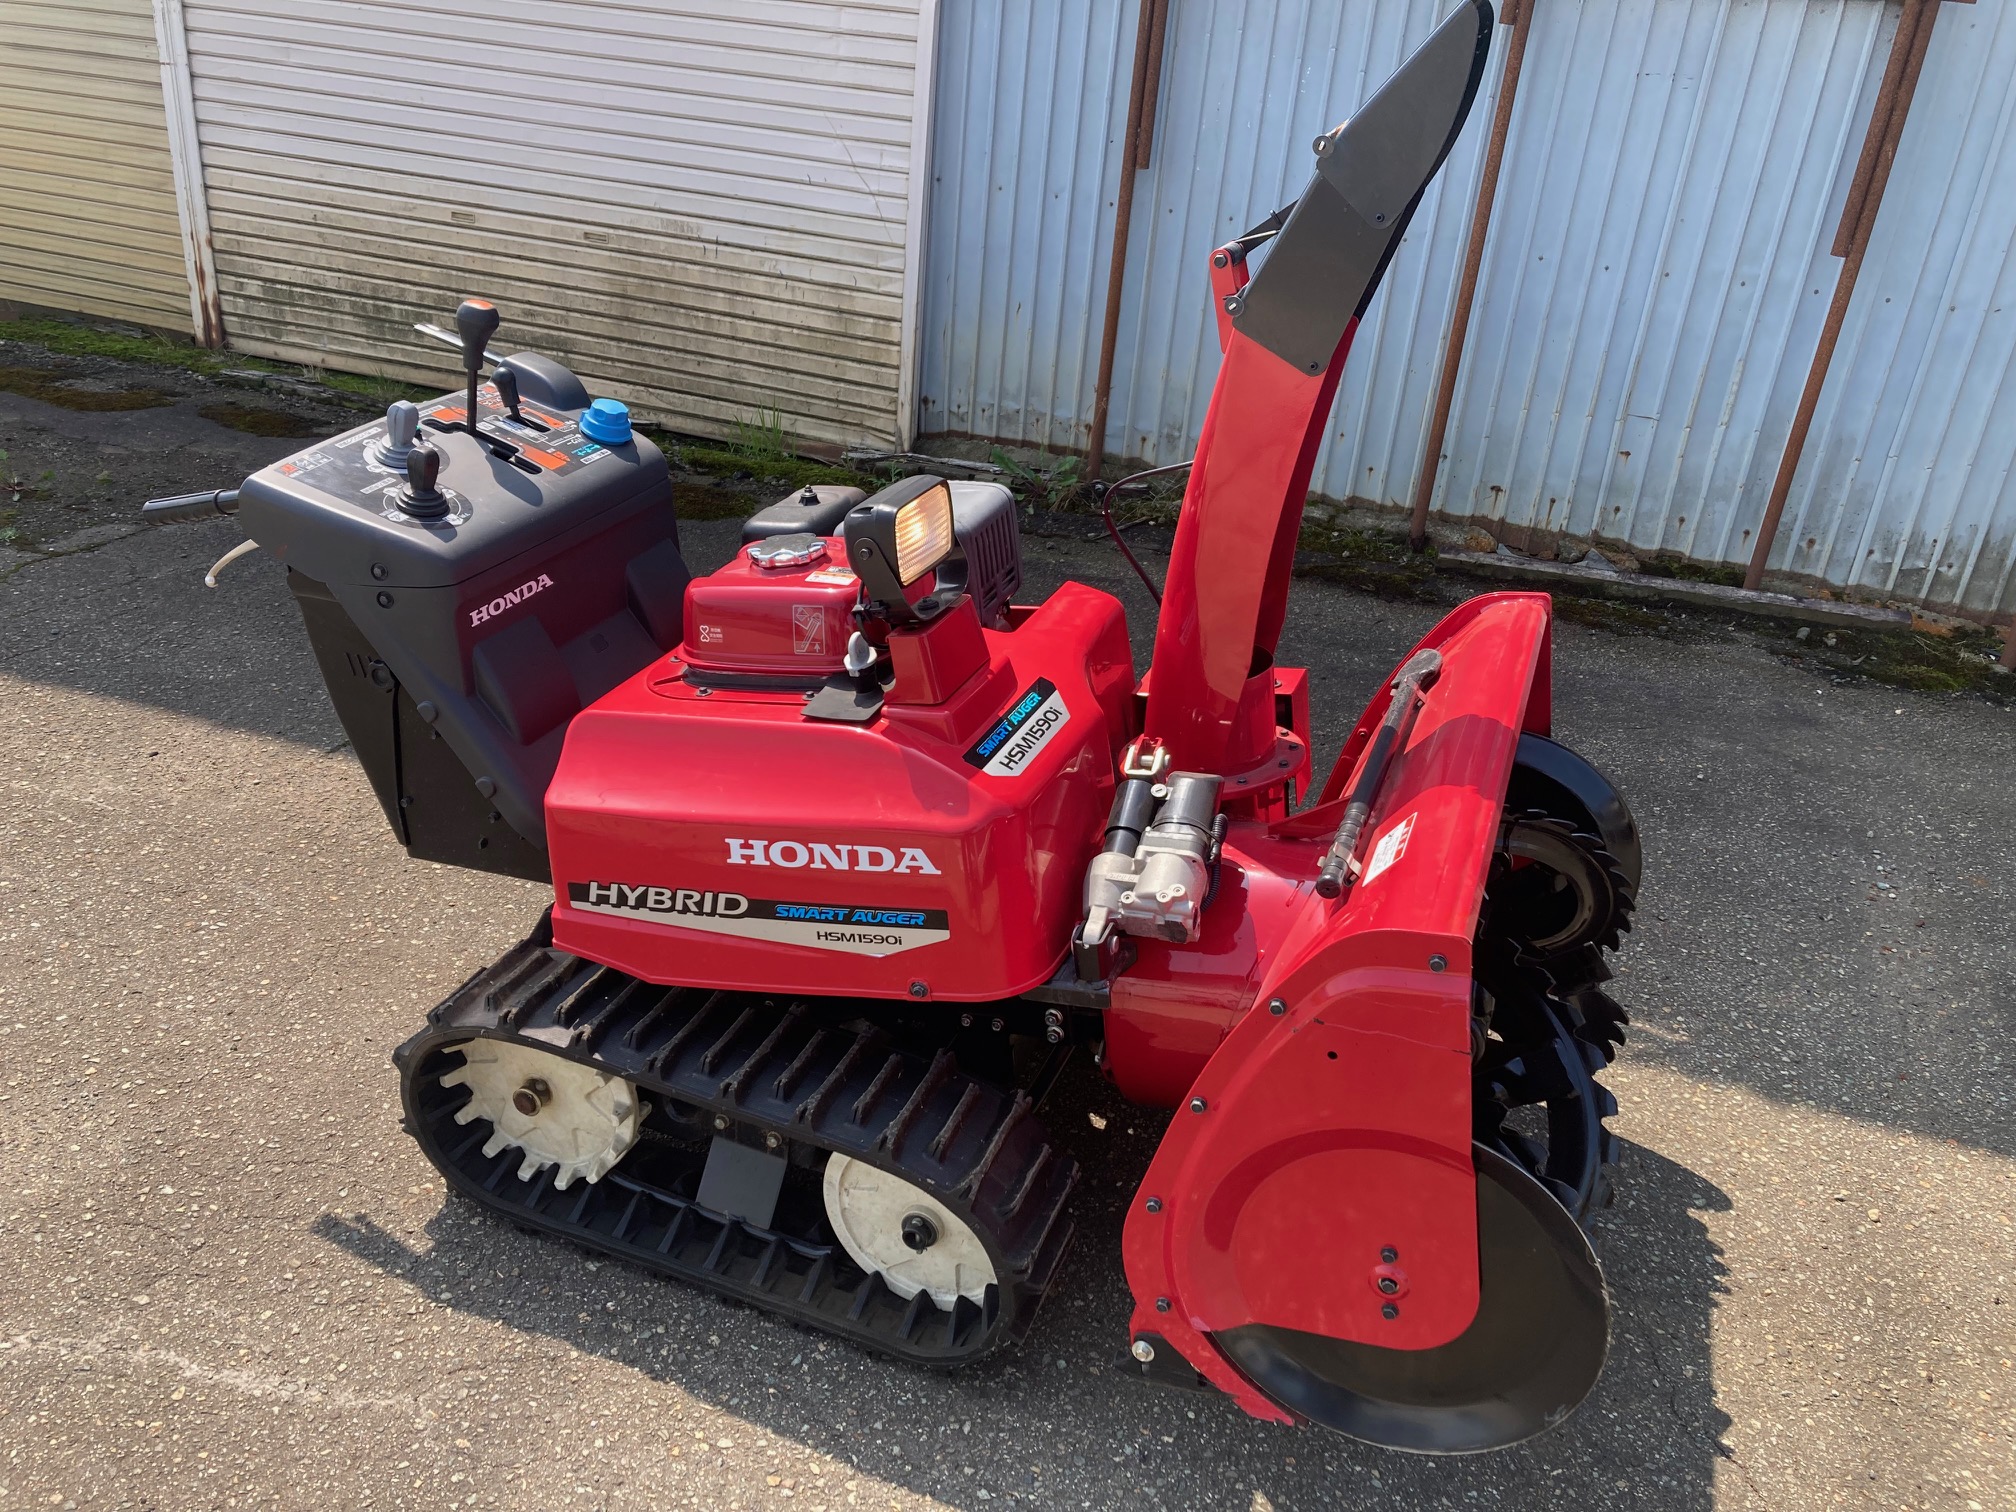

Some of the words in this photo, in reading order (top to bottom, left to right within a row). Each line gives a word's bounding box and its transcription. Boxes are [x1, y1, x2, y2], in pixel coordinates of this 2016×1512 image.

[470, 573, 553, 627] HONDA
[977, 721, 1012, 757] SMART
[1008, 691, 1042, 725] AUGER
[999, 706, 1063, 771] HSM1590i
[725, 838, 941, 875] HONDA
[588, 881, 749, 916] HYBRID
[775, 904, 850, 922] SMART
[850, 908, 926, 926] AUGER
[817, 930, 903, 946] HSM1590i
